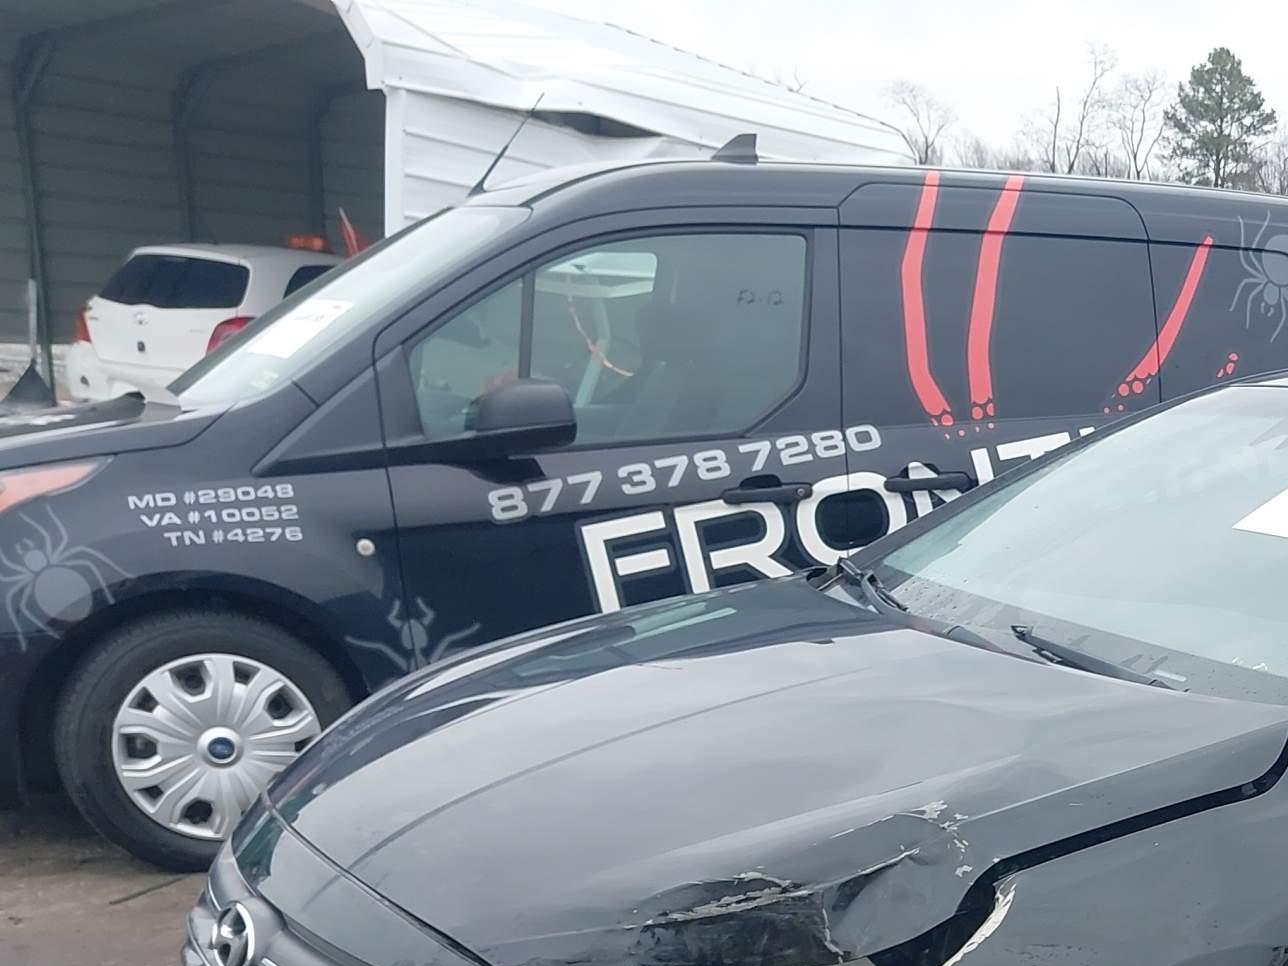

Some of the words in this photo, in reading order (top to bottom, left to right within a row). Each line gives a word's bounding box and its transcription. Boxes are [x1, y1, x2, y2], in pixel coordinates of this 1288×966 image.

[487, 470, 603, 525] 877
[617, 449, 731, 495] 378
[738, 424, 882, 473] 7280
[127, 491, 177, 510] MD
[183, 483, 294, 504] #29048
[140, 512, 182, 527] VA
[188, 504, 299, 525] #10052
[163, 530, 206, 547] TN
[212, 526, 303, 544] #4276
